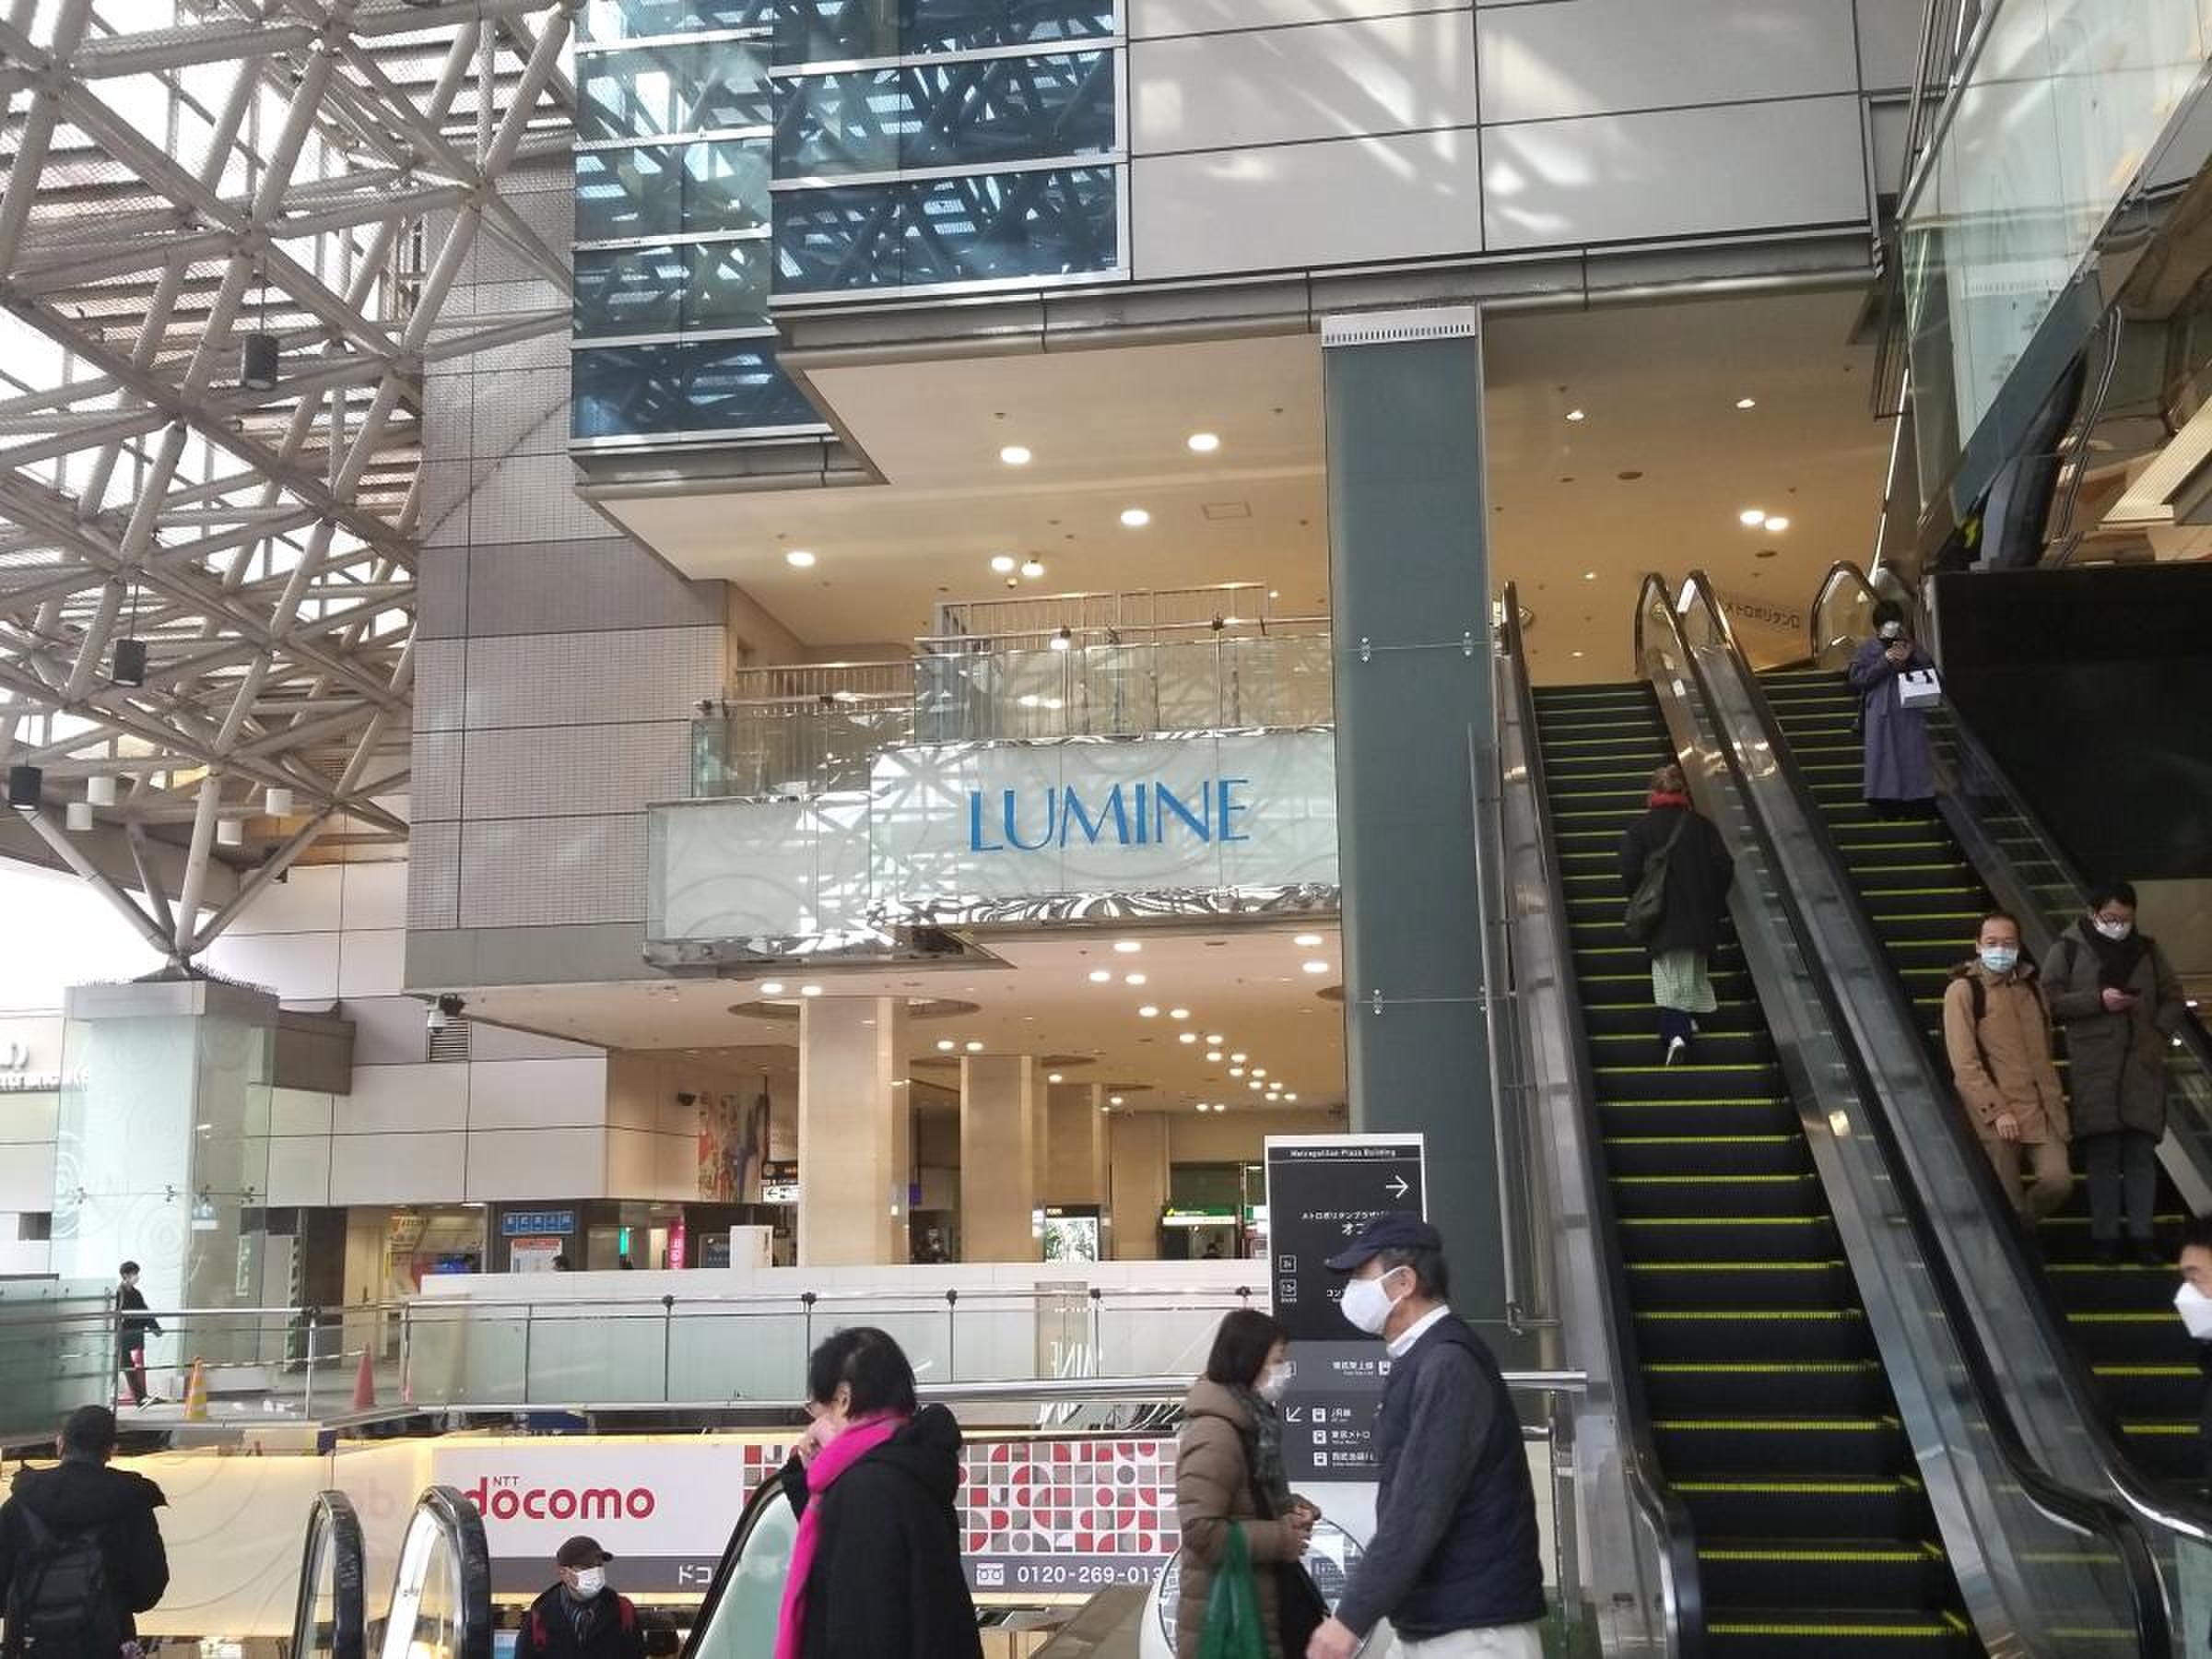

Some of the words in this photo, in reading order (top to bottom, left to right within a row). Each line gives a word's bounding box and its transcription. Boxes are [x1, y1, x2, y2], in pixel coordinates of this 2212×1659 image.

[971, 780, 1249, 852] LUMINE
[463, 1477, 655, 1520] docomo
[492, 1476, 520, 1487] NTT
